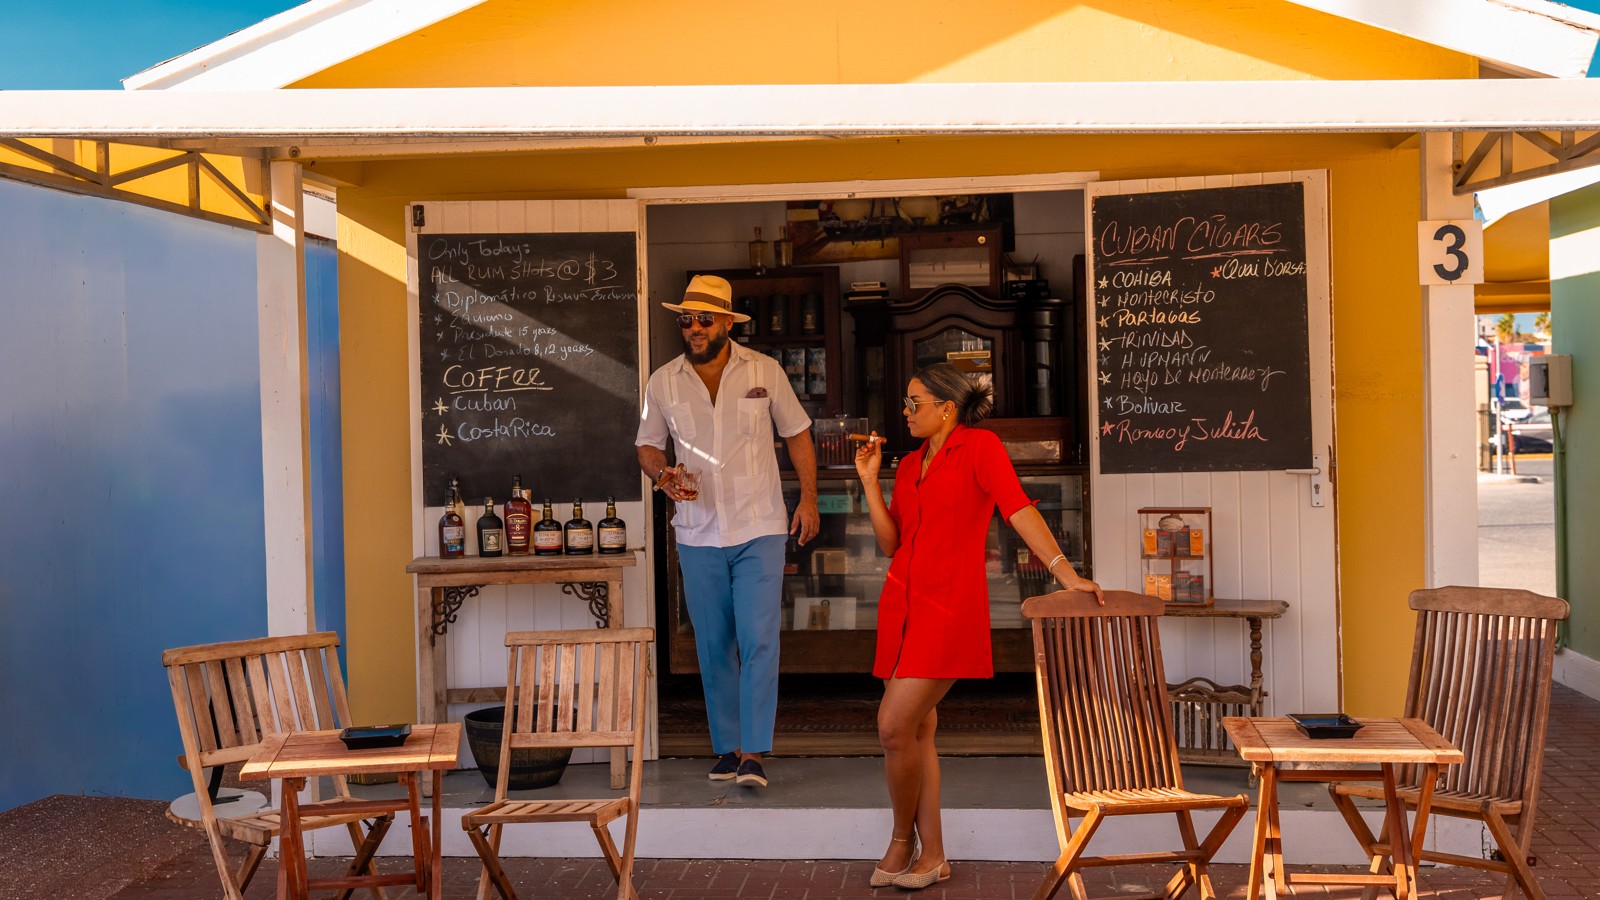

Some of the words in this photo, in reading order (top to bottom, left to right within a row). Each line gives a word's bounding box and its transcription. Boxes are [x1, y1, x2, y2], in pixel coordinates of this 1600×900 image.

[1101, 217, 1194, 256] CUBAN
[429, 239, 468, 265] Only
[468, 240, 530, 264] Today:
[1433, 224, 1469, 281] 3
[431, 265, 459, 284] ALL
[468, 265, 504, 280] RUM
[518, 326, 529, 337] 15
[484, 343, 531, 358] Dorado
[455, 393, 516, 411] Cuban
